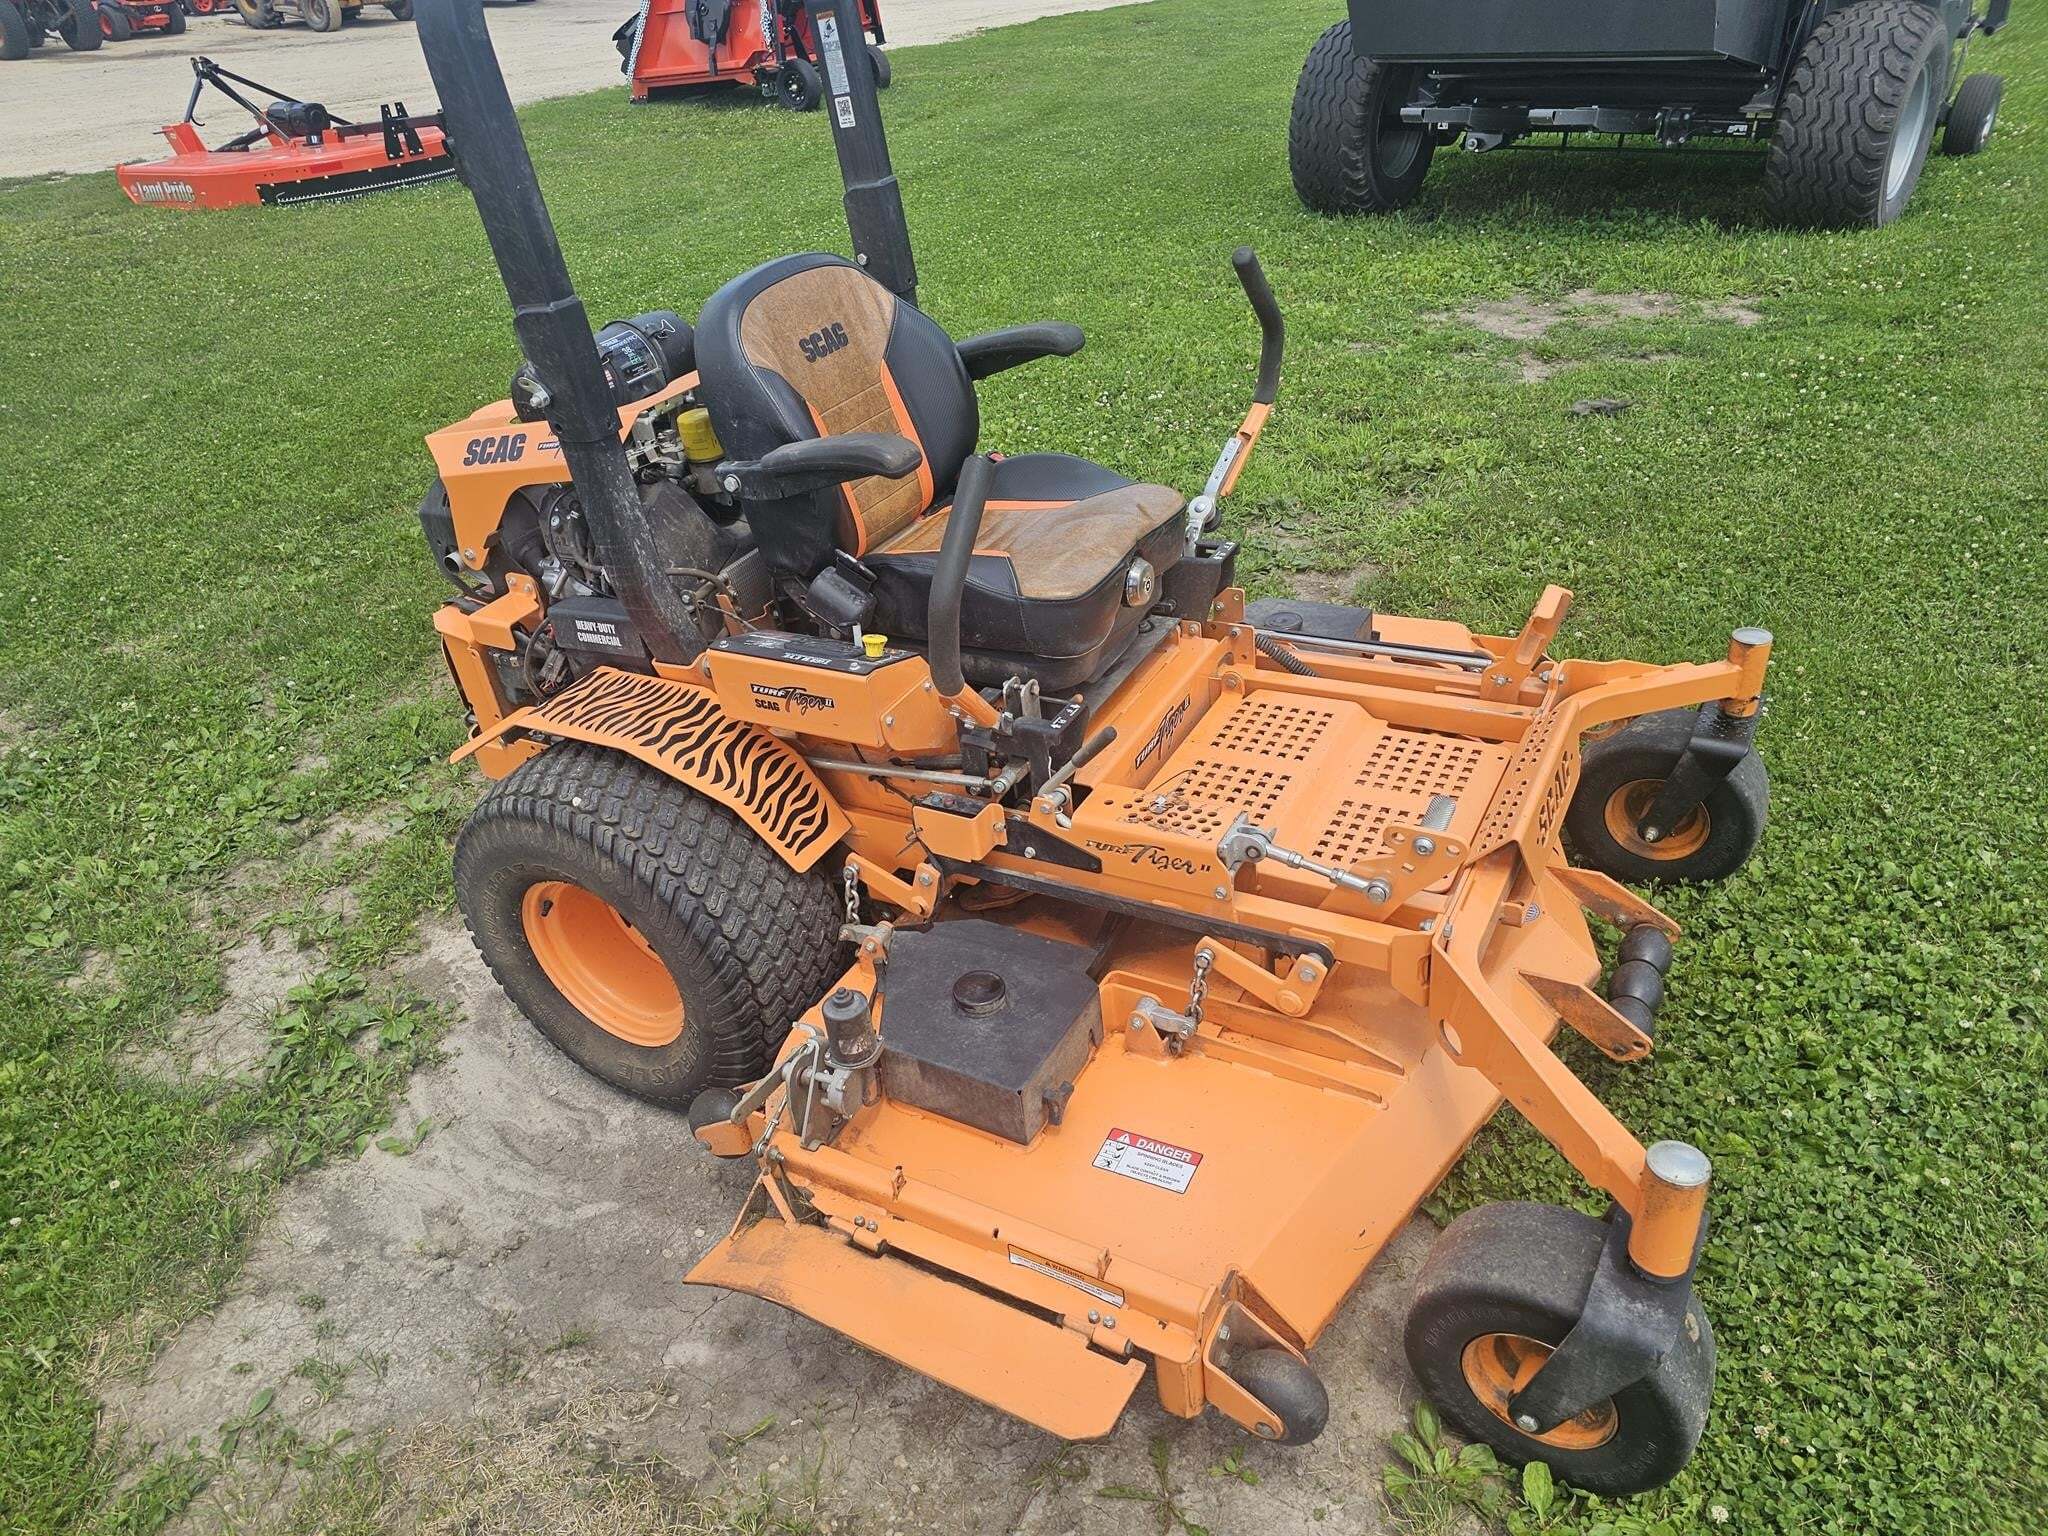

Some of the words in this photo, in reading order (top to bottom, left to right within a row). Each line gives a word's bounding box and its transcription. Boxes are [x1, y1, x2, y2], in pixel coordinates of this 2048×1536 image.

[136, 182, 164, 201] Land
[162, 181, 196, 201] Pride
[799, 322, 849, 363] SCAG
[463, 433, 527, 466] SCAG
[575, 619, 616, 634] HEAVY-DUTY
[577, 632, 622, 647] COMMERCIAL
[752, 685, 787, 697] TURF
[779, 686, 824, 716] Tiger
[755, 698, 780, 711] SCAG
[1136, 735, 1159, 768] TURF
[1536, 750, 1573, 847] SCAG
[1136, 1138, 1192, 1162] DANGER
